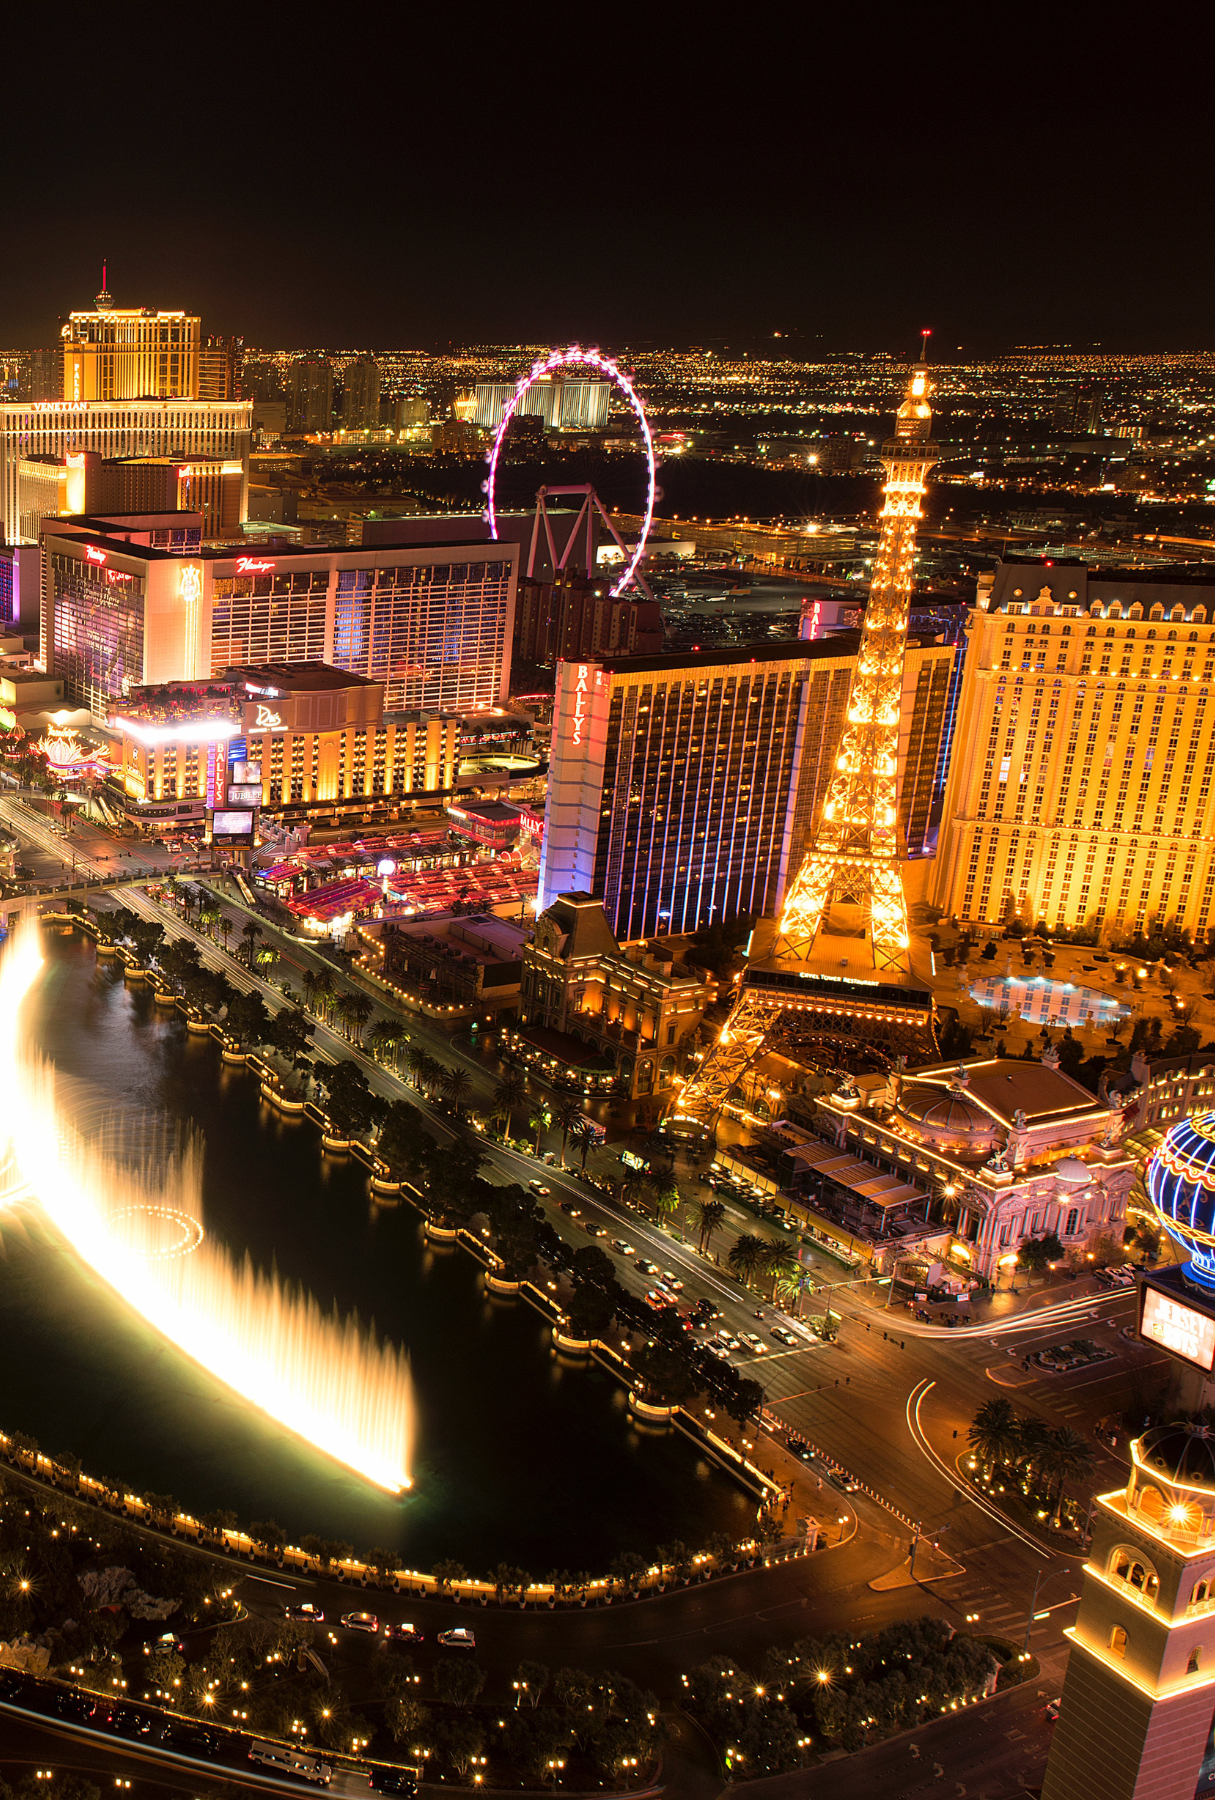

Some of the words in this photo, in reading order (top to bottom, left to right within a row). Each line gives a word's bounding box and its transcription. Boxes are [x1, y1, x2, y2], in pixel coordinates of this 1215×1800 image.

[33, 402, 88, 411] VENETIAN
[236, 557, 275, 573] Flamingo
[572, 665, 588, 745] BALLYS
[215, 742, 225, 801] BALLYS
[228, 790, 263, 802] JUBILEE
[1155, 1298, 1207, 1338] JERSEY
